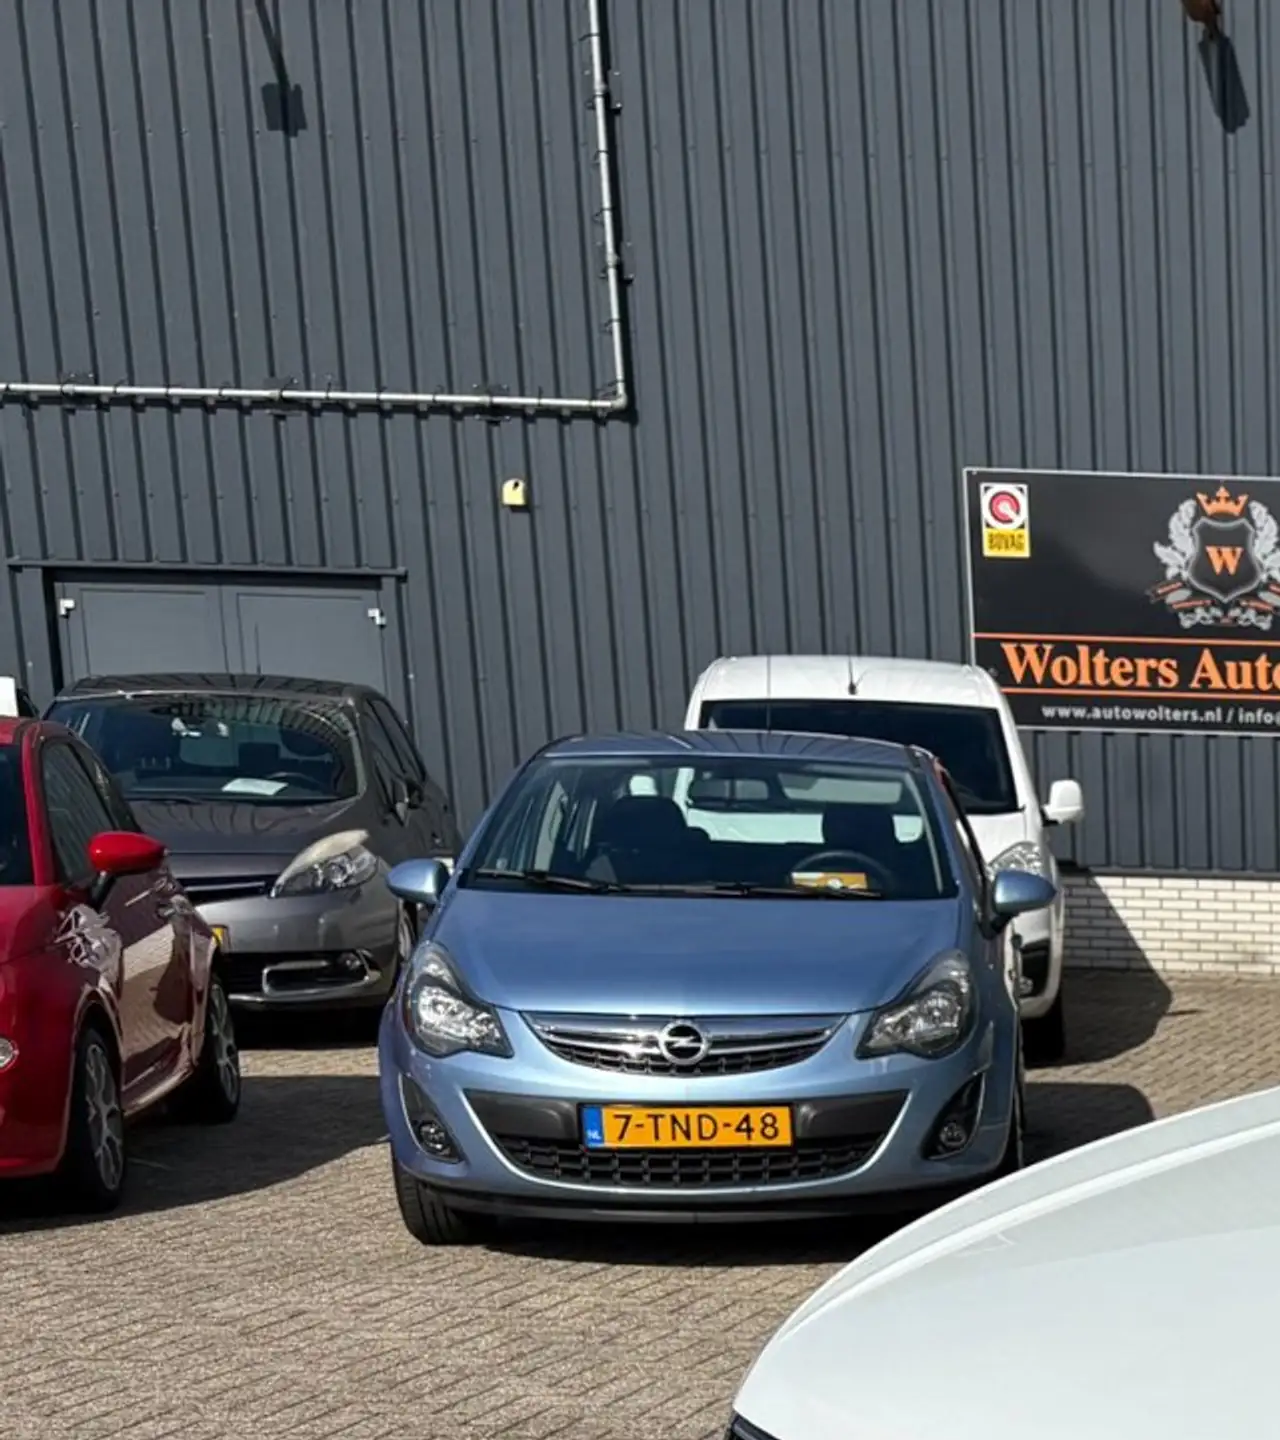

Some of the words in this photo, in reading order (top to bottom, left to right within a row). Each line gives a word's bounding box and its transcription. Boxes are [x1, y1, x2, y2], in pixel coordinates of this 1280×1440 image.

[1205, 545, 1244, 576] W
[1000, 641, 1179, 688] Wolters
[1041, 704, 1222, 723] www.autowolters.nl
[613, 1111, 779, 1142] 7-TND-48
